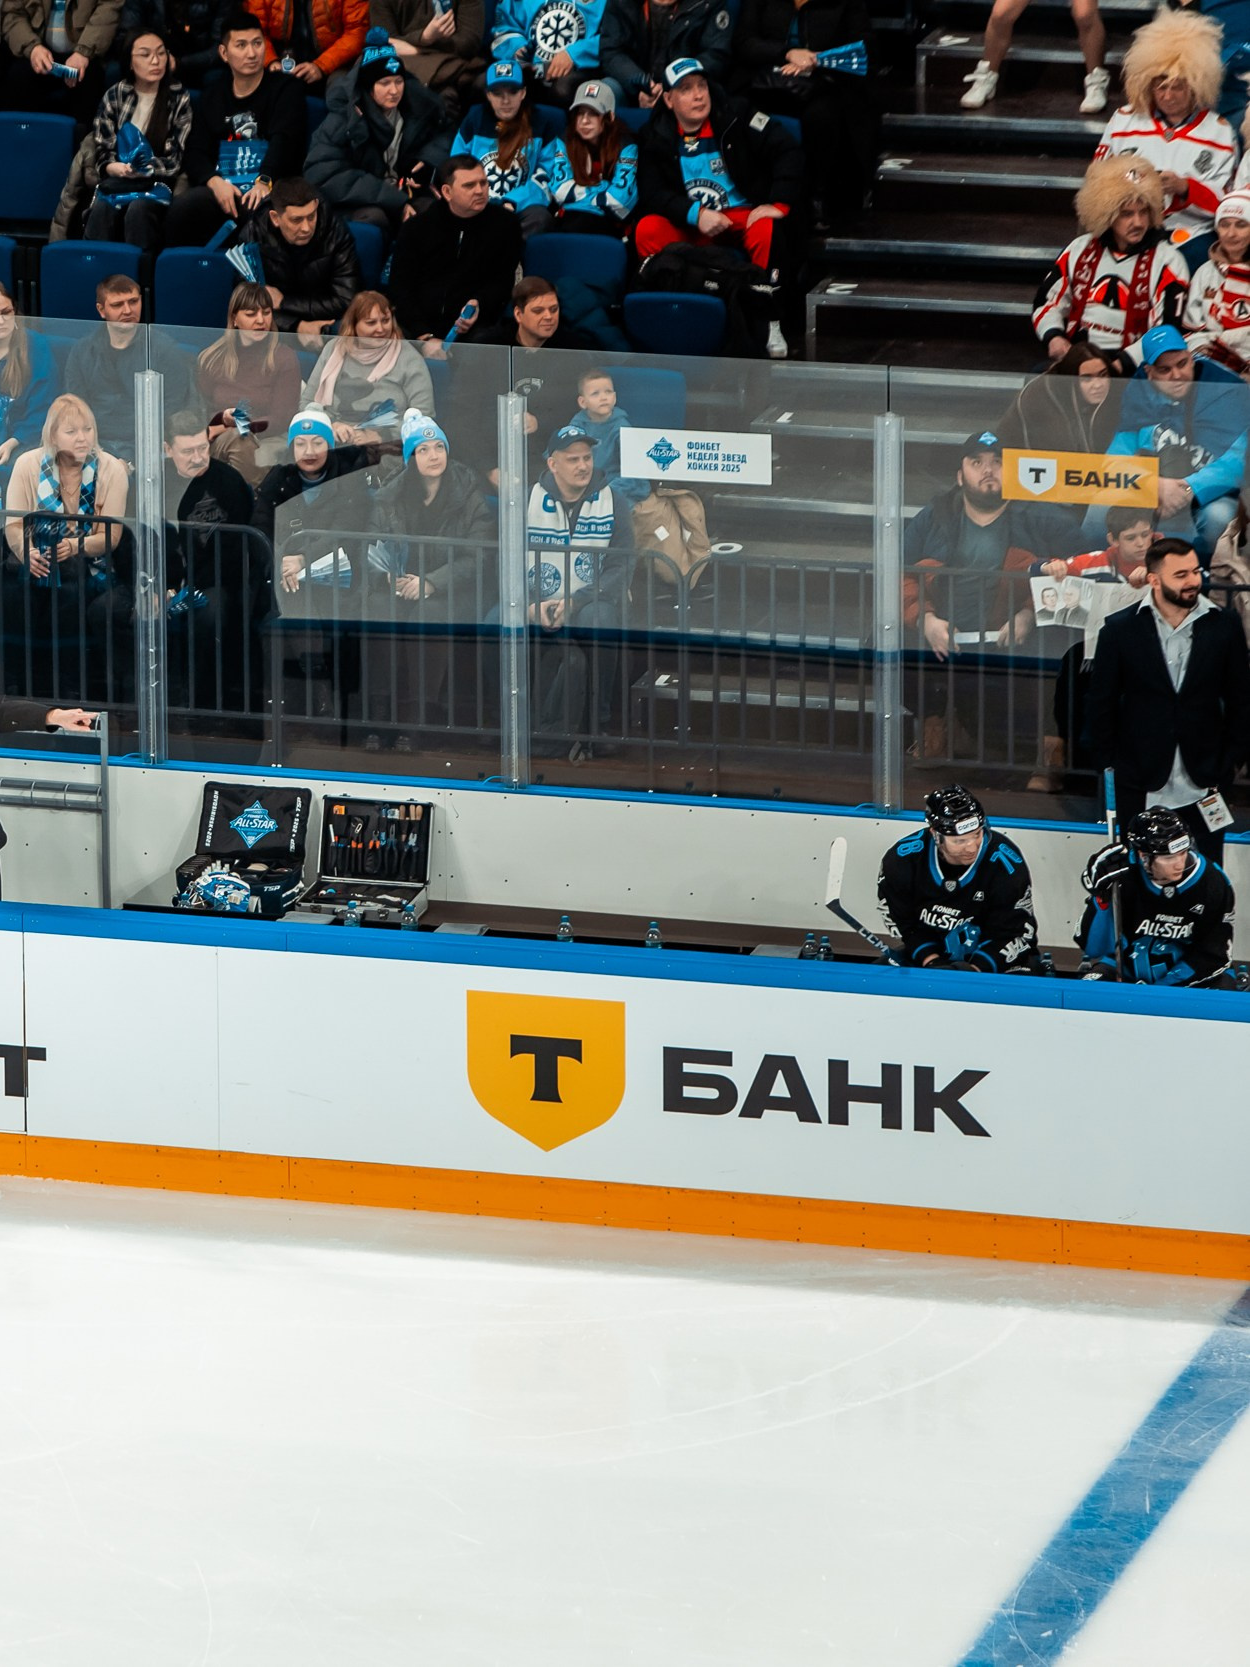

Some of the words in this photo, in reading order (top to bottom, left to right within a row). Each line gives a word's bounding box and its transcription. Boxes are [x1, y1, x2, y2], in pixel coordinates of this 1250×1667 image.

[686, 441, 721, 451] ФОНБЕТ
[687, 451, 719, 462] НЕДЕЛЯ
[721, 453, 747, 464] ЗВЕЗД
[687, 461, 719, 472] ХОККЕЯ
[721, 463, 741, 473] 2025
[1028, 467, 1047, 484] Т
[1064, 469, 1142, 490] БАНК
[931, 904, 962, 918] FONBET
[1154, 913, 1185, 925] FONBET
[857, 926, 890, 954] CCM
[509, 1033, 583, 1104] Т
[662, 1045, 992, 1138] БАНК
